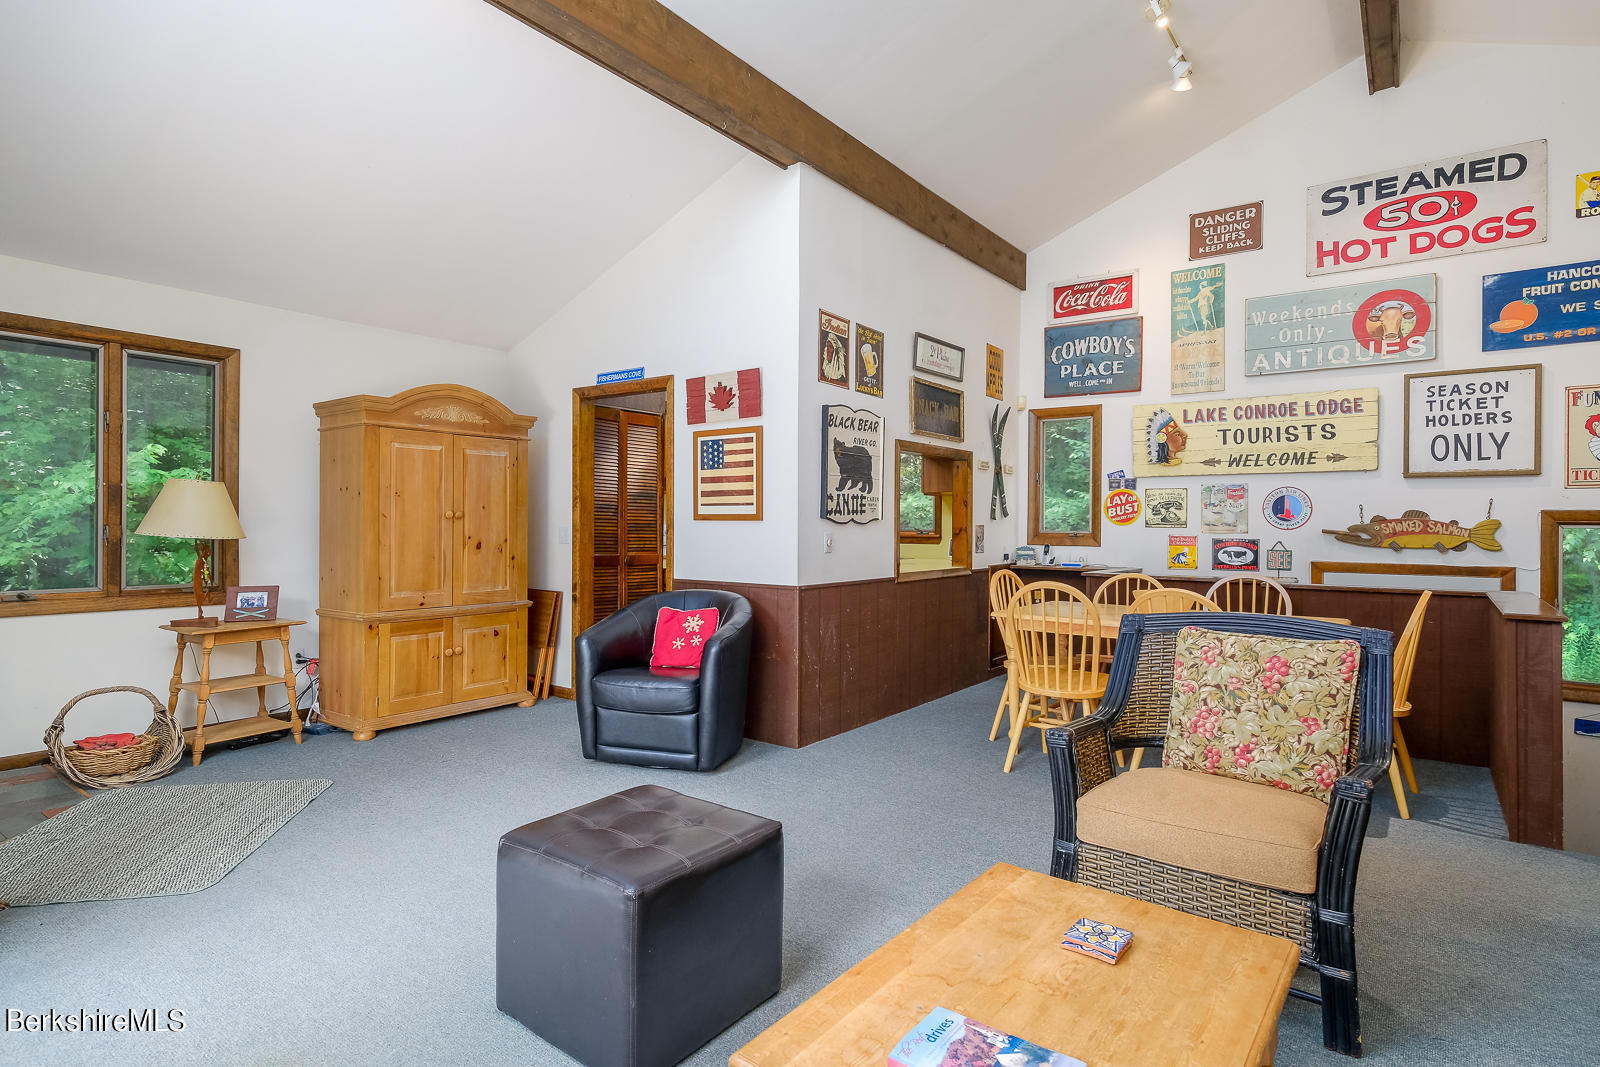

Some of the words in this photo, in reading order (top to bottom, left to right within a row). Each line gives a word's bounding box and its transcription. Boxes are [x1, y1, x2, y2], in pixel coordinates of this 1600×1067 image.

[1320, 152, 1528, 218] STEAMED
[1194, 207, 1257, 228] DANGER
[1202, 220, 1251, 237] SLIDING
[1206, 230, 1246, 245] CLIFFS
[1316, 236, 1398, 269] HOT
[1409, 205, 1537, 255] DOGS
[1198, 243, 1224, 254] KEEP
[1226, 238, 1254, 249] BACK
[1172, 267, 1222, 284] WELCOME
[1073, 281, 1101, 291] DRINK
[1522, 282, 1565, 298] FRUIT
[1055, 281, 1130, 314] Coca-Cola
[1252, 299, 1356, 328] Weekends
[1560, 301, 1586, 313] WE
[823, 317, 848, 337] Indian
[1523, 332, 1548, 342] U.S.
[1553, 329, 1572, 338] #2
[1577, 327, 1597, 336] OR
[1050, 335, 1136, 365] COWBOY'S
[1251, 335, 1427, 373] ANTIQUES
[599, 373, 628, 382] FISHERMANS
[628, 370, 642, 378] COVE
[1060, 360, 1125, 379] PLACE
[1426, 380, 1509, 398] SEASON
[1182, 406, 1228, 425] LAKE
[1233, 401, 1299, 422] CONROE
[1304, 397, 1364, 417] LODGE
[1425, 395, 1504, 412] TICKET
[828, 413, 857, 432] BLACK
[857, 418, 880, 433] BEAR
[1425, 410, 1513, 428] HOLDERS
[853, 437, 868, 447] RIVER
[1216, 423, 1337, 446] TOURISTS
[1430, 431, 1511, 462] ONLY
[1227, 451, 1319, 468] WELCOME
[1571, 470, 1600, 481] TIC
[826, 493, 867, 516] CANOE
[1107, 493, 1129, 507] LAY
[1108, 502, 1140, 517] BUST
[1380, 519, 1424, 536] SMOKED
[1427, 519, 1470, 538] SALMON
[1268, 551, 1291, 569] SEE
[925, 1018, 955, 1043] drives
